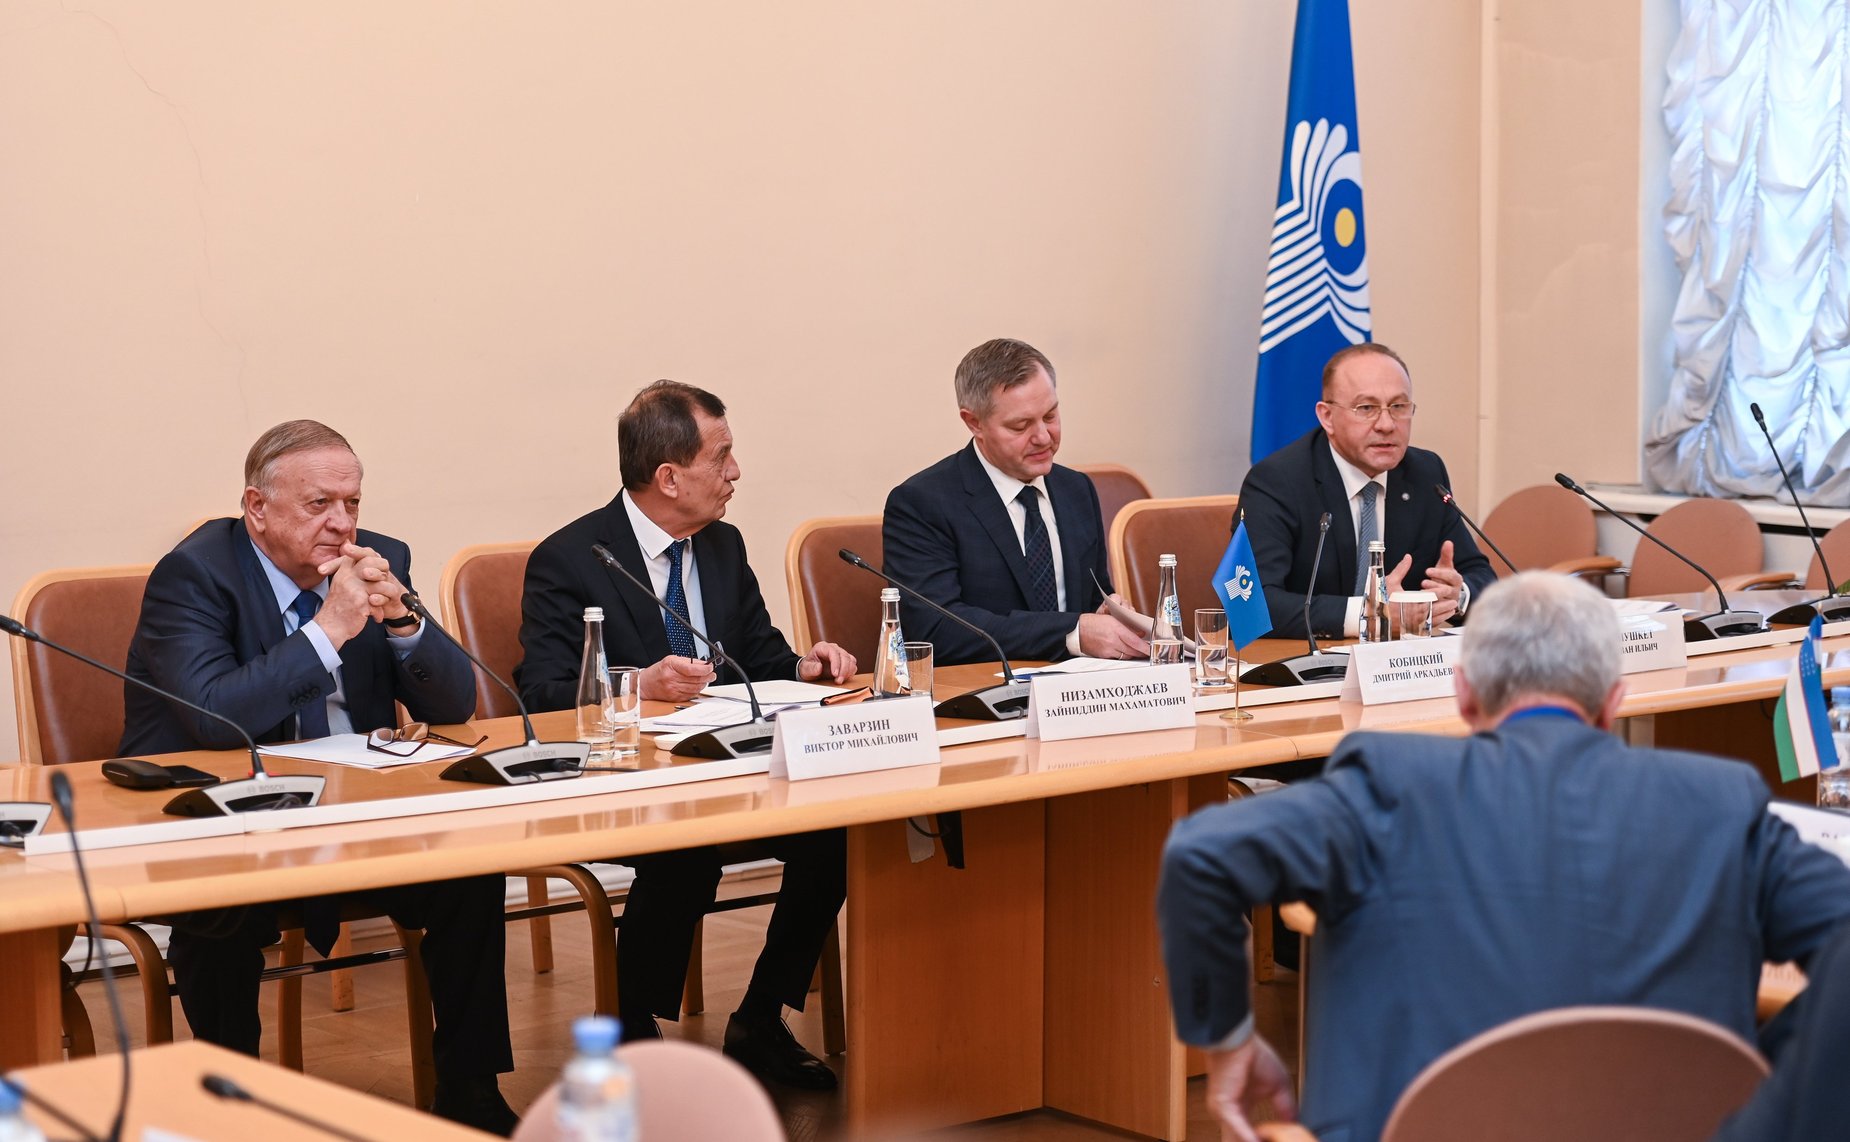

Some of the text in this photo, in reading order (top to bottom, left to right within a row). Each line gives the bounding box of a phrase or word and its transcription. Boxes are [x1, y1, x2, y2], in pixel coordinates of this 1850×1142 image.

[1635, 642, 1658, 652] ИЛЬИЧ
[1389, 652, 1444, 668] КОБИЦКИЙ
[1372, 667, 1456, 684] ДМИТРИЙ АРКАДЬЕВ
[1061, 683, 1168, 702] НИЗАМХОДЖАЕВ
[1045, 696, 1186, 718] ЗАЙНИДДИН МАХАМАТОВИЧ
[828, 719, 891, 736] ЗАВАРЗИН
[804, 732, 919, 754] ВИКТОР МИХАЙЛОВИЧ
